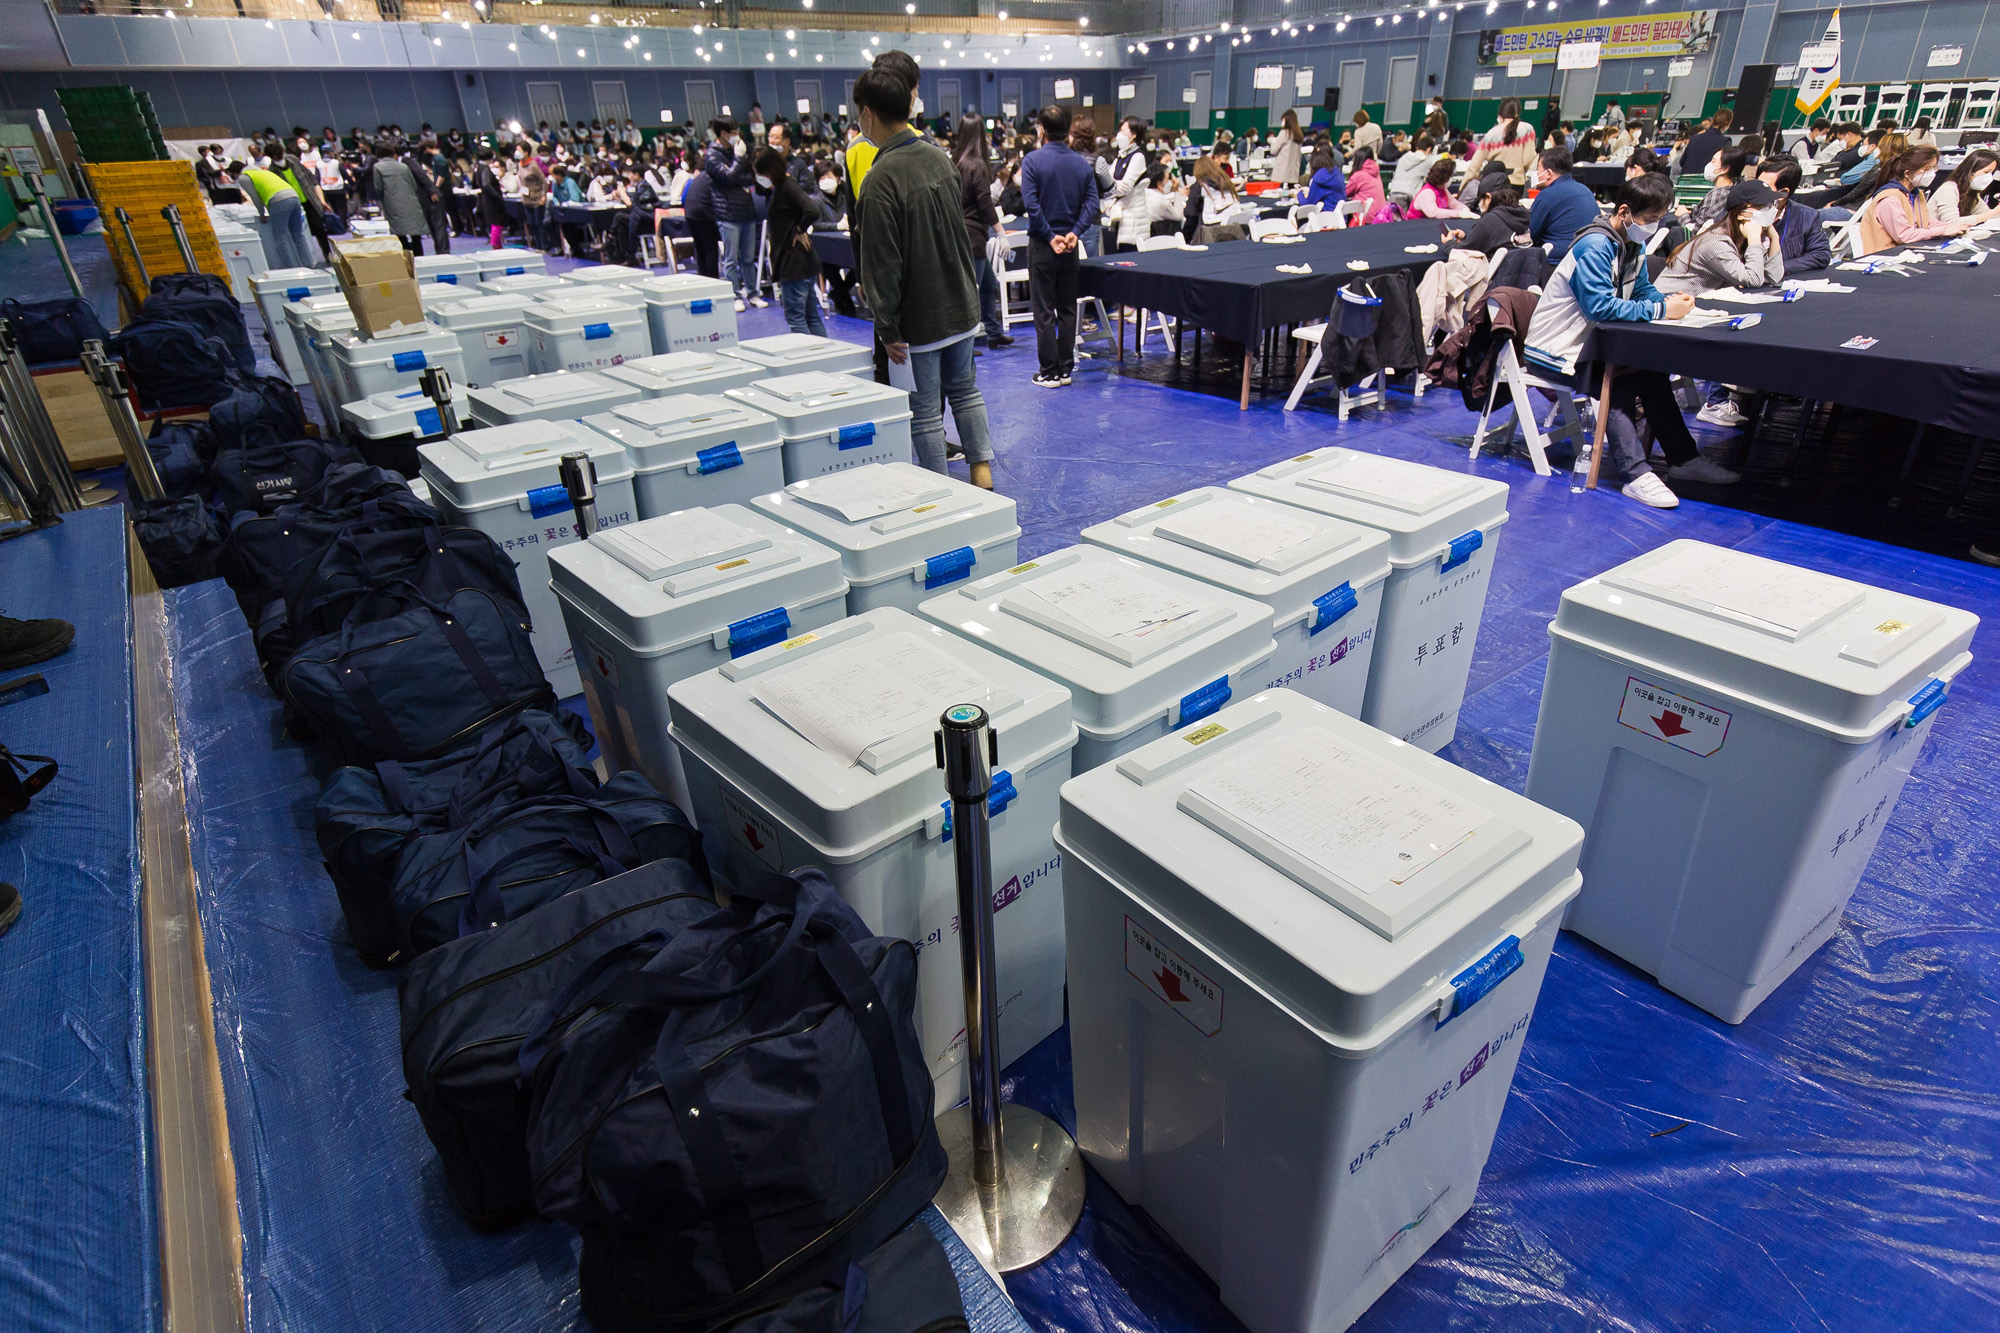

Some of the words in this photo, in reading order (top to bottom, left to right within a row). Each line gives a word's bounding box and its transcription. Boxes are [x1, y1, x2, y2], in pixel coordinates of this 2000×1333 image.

[1494, 33, 1528, 52] 배드민턴
[1529, 30, 1563, 49] 고수되는
[1611, 23, 1650, 43] 배드민턴
[1652, 20, 1691, 41] 필라테스
[256, 476, 293, 491] 선거사무
[500, 533, 539, 551] 주주의
[543, 526, 570, 541] 꽃은
[598, 511, 630, 528] 입니다
[1307, 654, 1326, 675] 꽃은
[1330, 628, 1372, 662] 선거입니다
[1414, 622, 1464, 666] 투표함
[1634, 687, 1655, 702] 이곳을
[1656, 696, 1671, 708] 잡고
[1673, 702, 1695, 717] 이동해
[1697, 710, 1720, 727] 주세요
[1831, 795, 1888, 859] 투표함
[993, 854, 1061, 908] 선거입니다
[913, 928, 941, 956] 주의
[1132, 930, 1152, 952] 이곳을
[1154, 948, 1167, 964] 잡고
[1169, 959, 1191, 982] 이동해
[1192, 976, 1215, 1000] 주세요
[1349, 1112, 1414, 1175] 민주주의
[1421, 1080, 1453, 1118] 꽃은
[1459, 1012, 1529, 1084] 선거입니다
